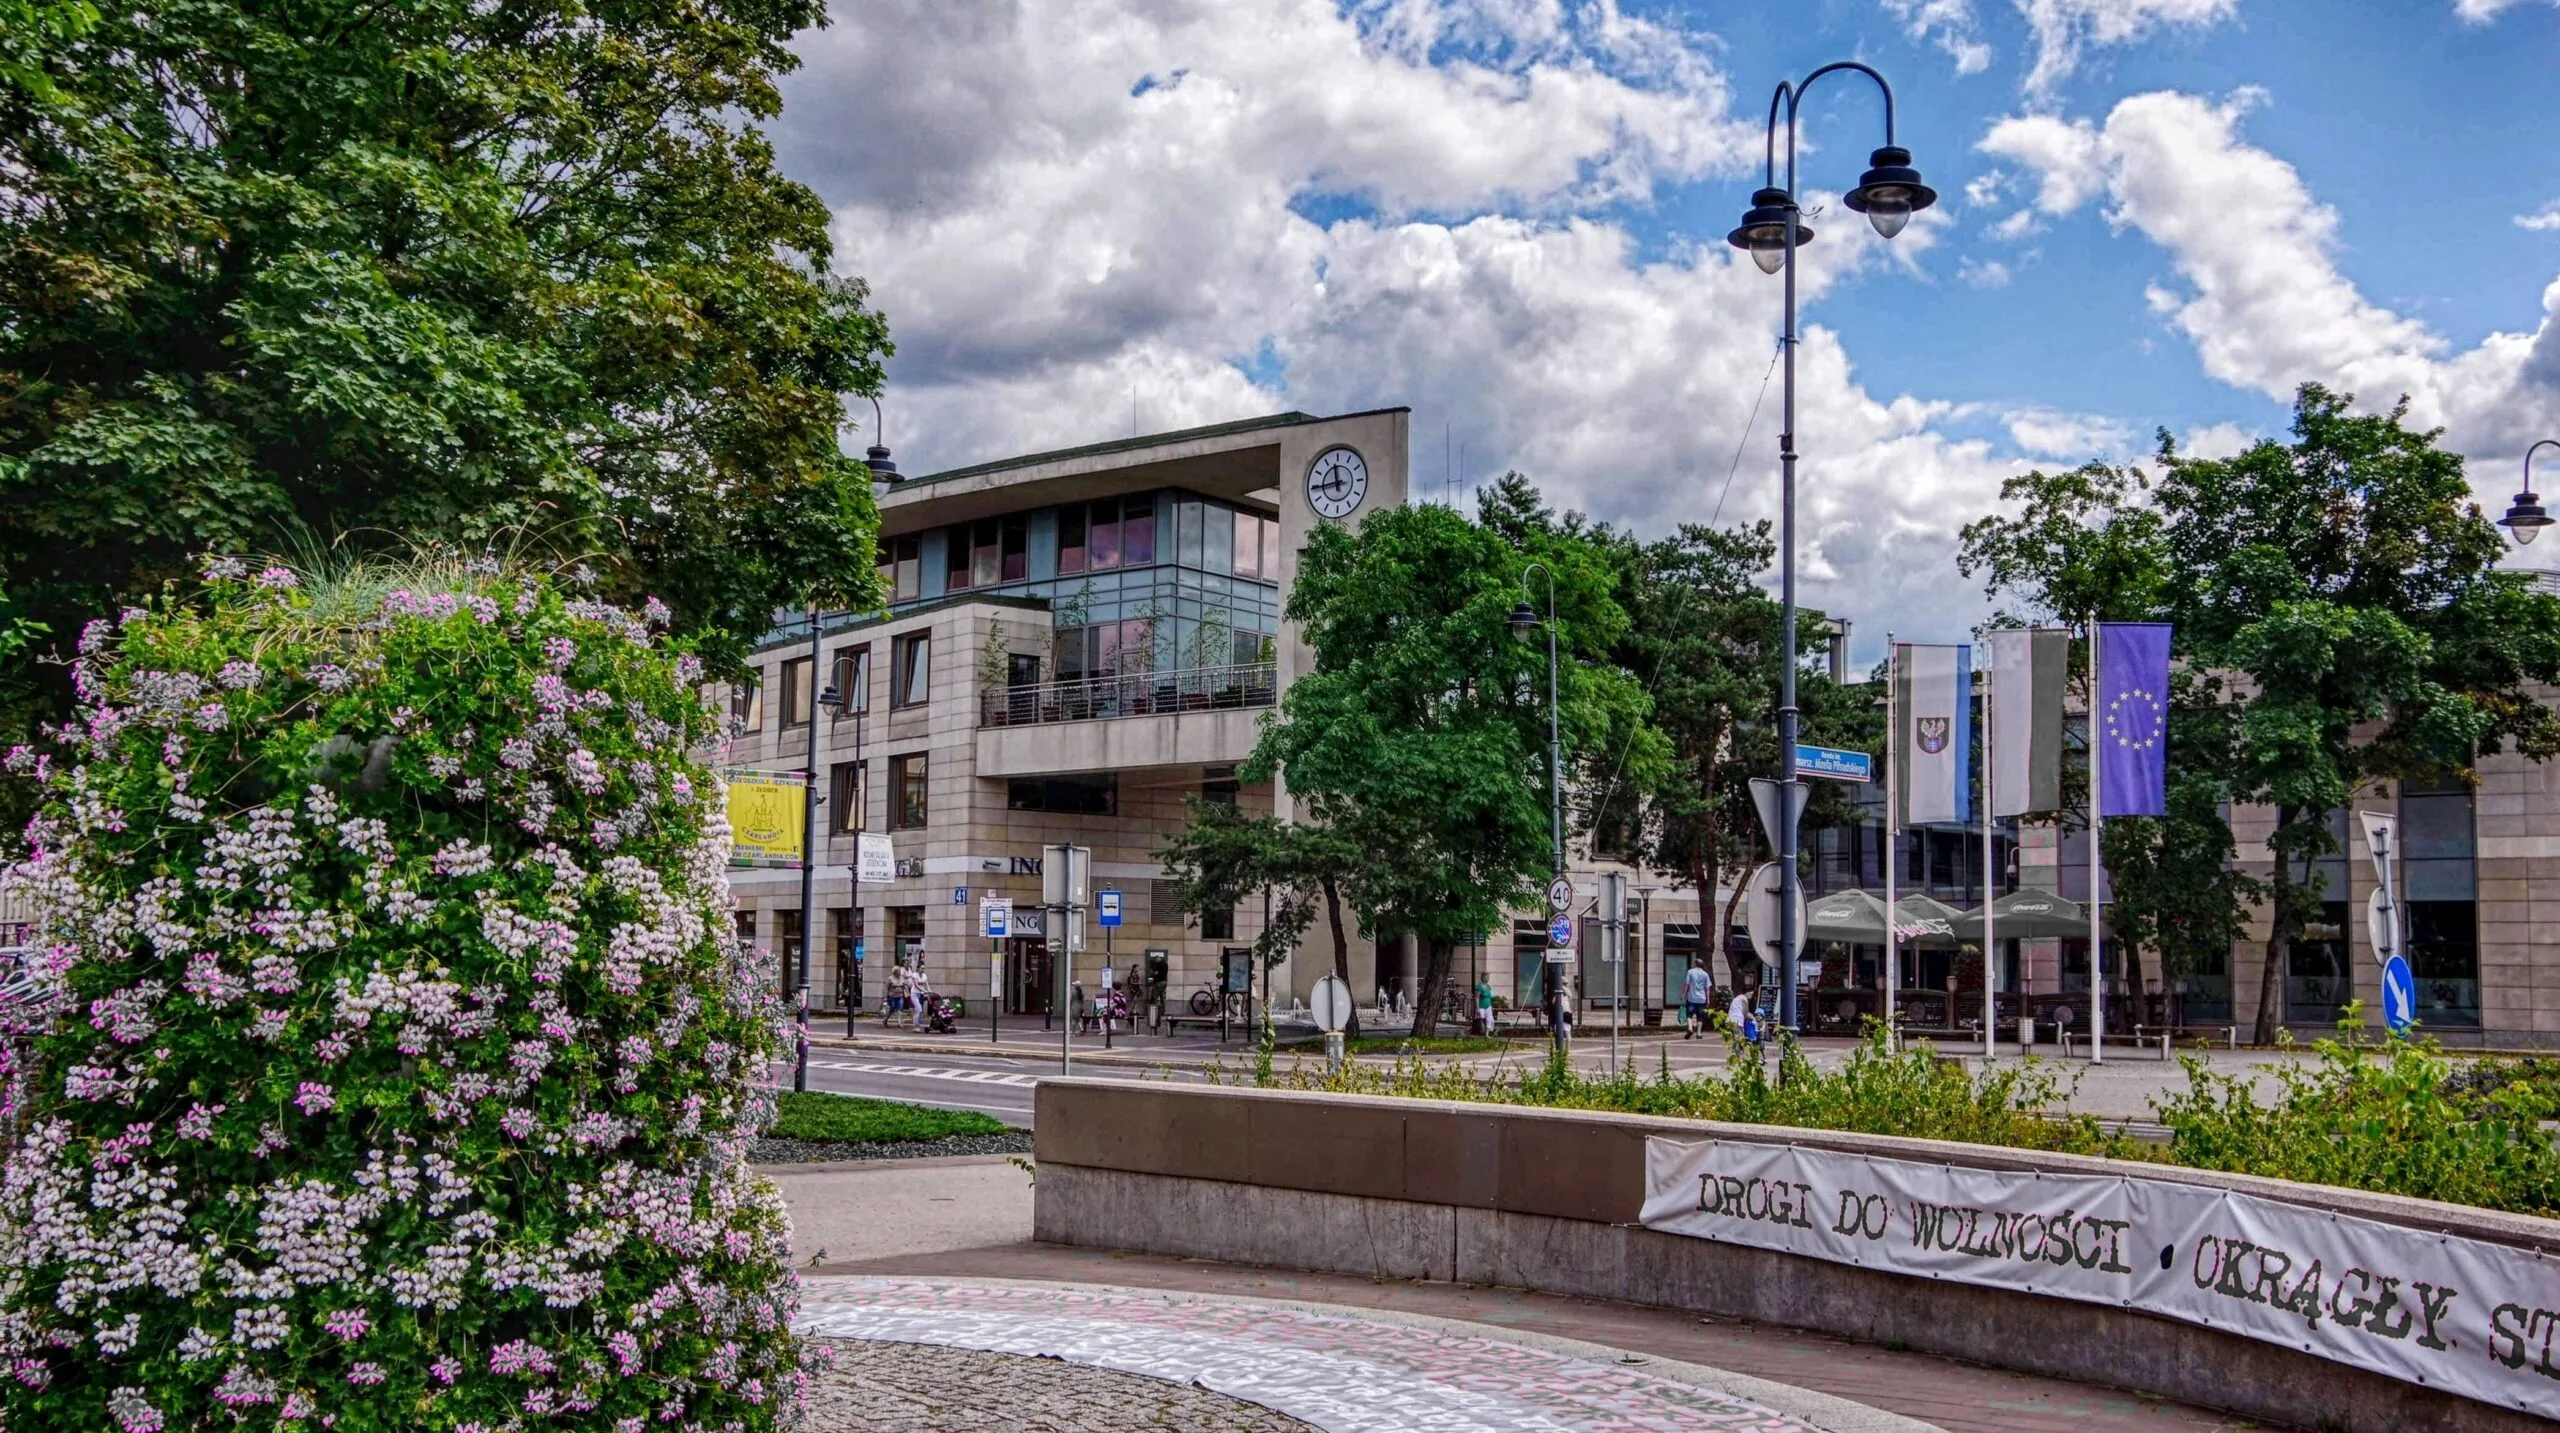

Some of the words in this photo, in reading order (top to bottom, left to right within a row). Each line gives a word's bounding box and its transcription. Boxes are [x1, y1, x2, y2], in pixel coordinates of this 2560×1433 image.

[956, 888, 966, 904] 41
[1553, 887, 1570, 904] 40
[1012, 916, 1038, 929] NG
[1696, 1173, 1812, 1229] DROGI
[1832, 1189, 1888, 1240] DO
[1910, 1201, 2132, 1274] WOLNOŚCI
[2193, 1234, 2459, 1353] OKRĄGŁY
